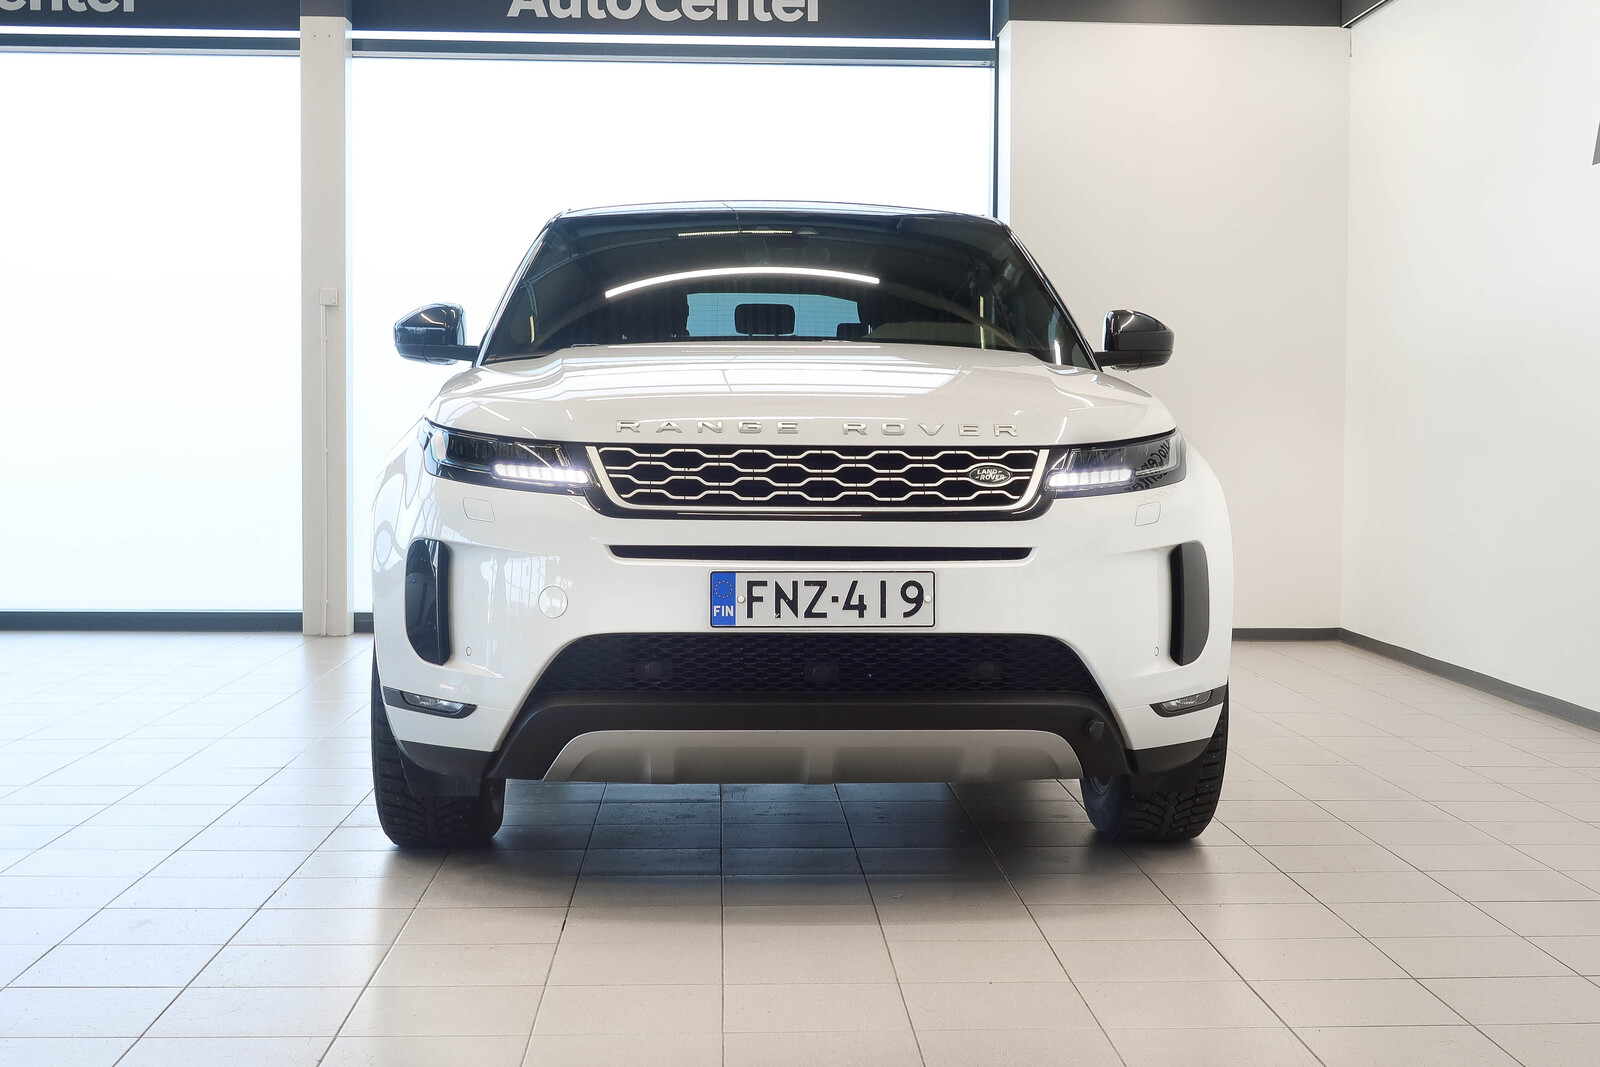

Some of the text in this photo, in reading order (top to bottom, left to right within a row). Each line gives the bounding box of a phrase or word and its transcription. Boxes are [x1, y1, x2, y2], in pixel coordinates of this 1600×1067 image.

[616, 419, 1018, 437] RANGE ROVER
[713, 606, 734, 617] FIN
